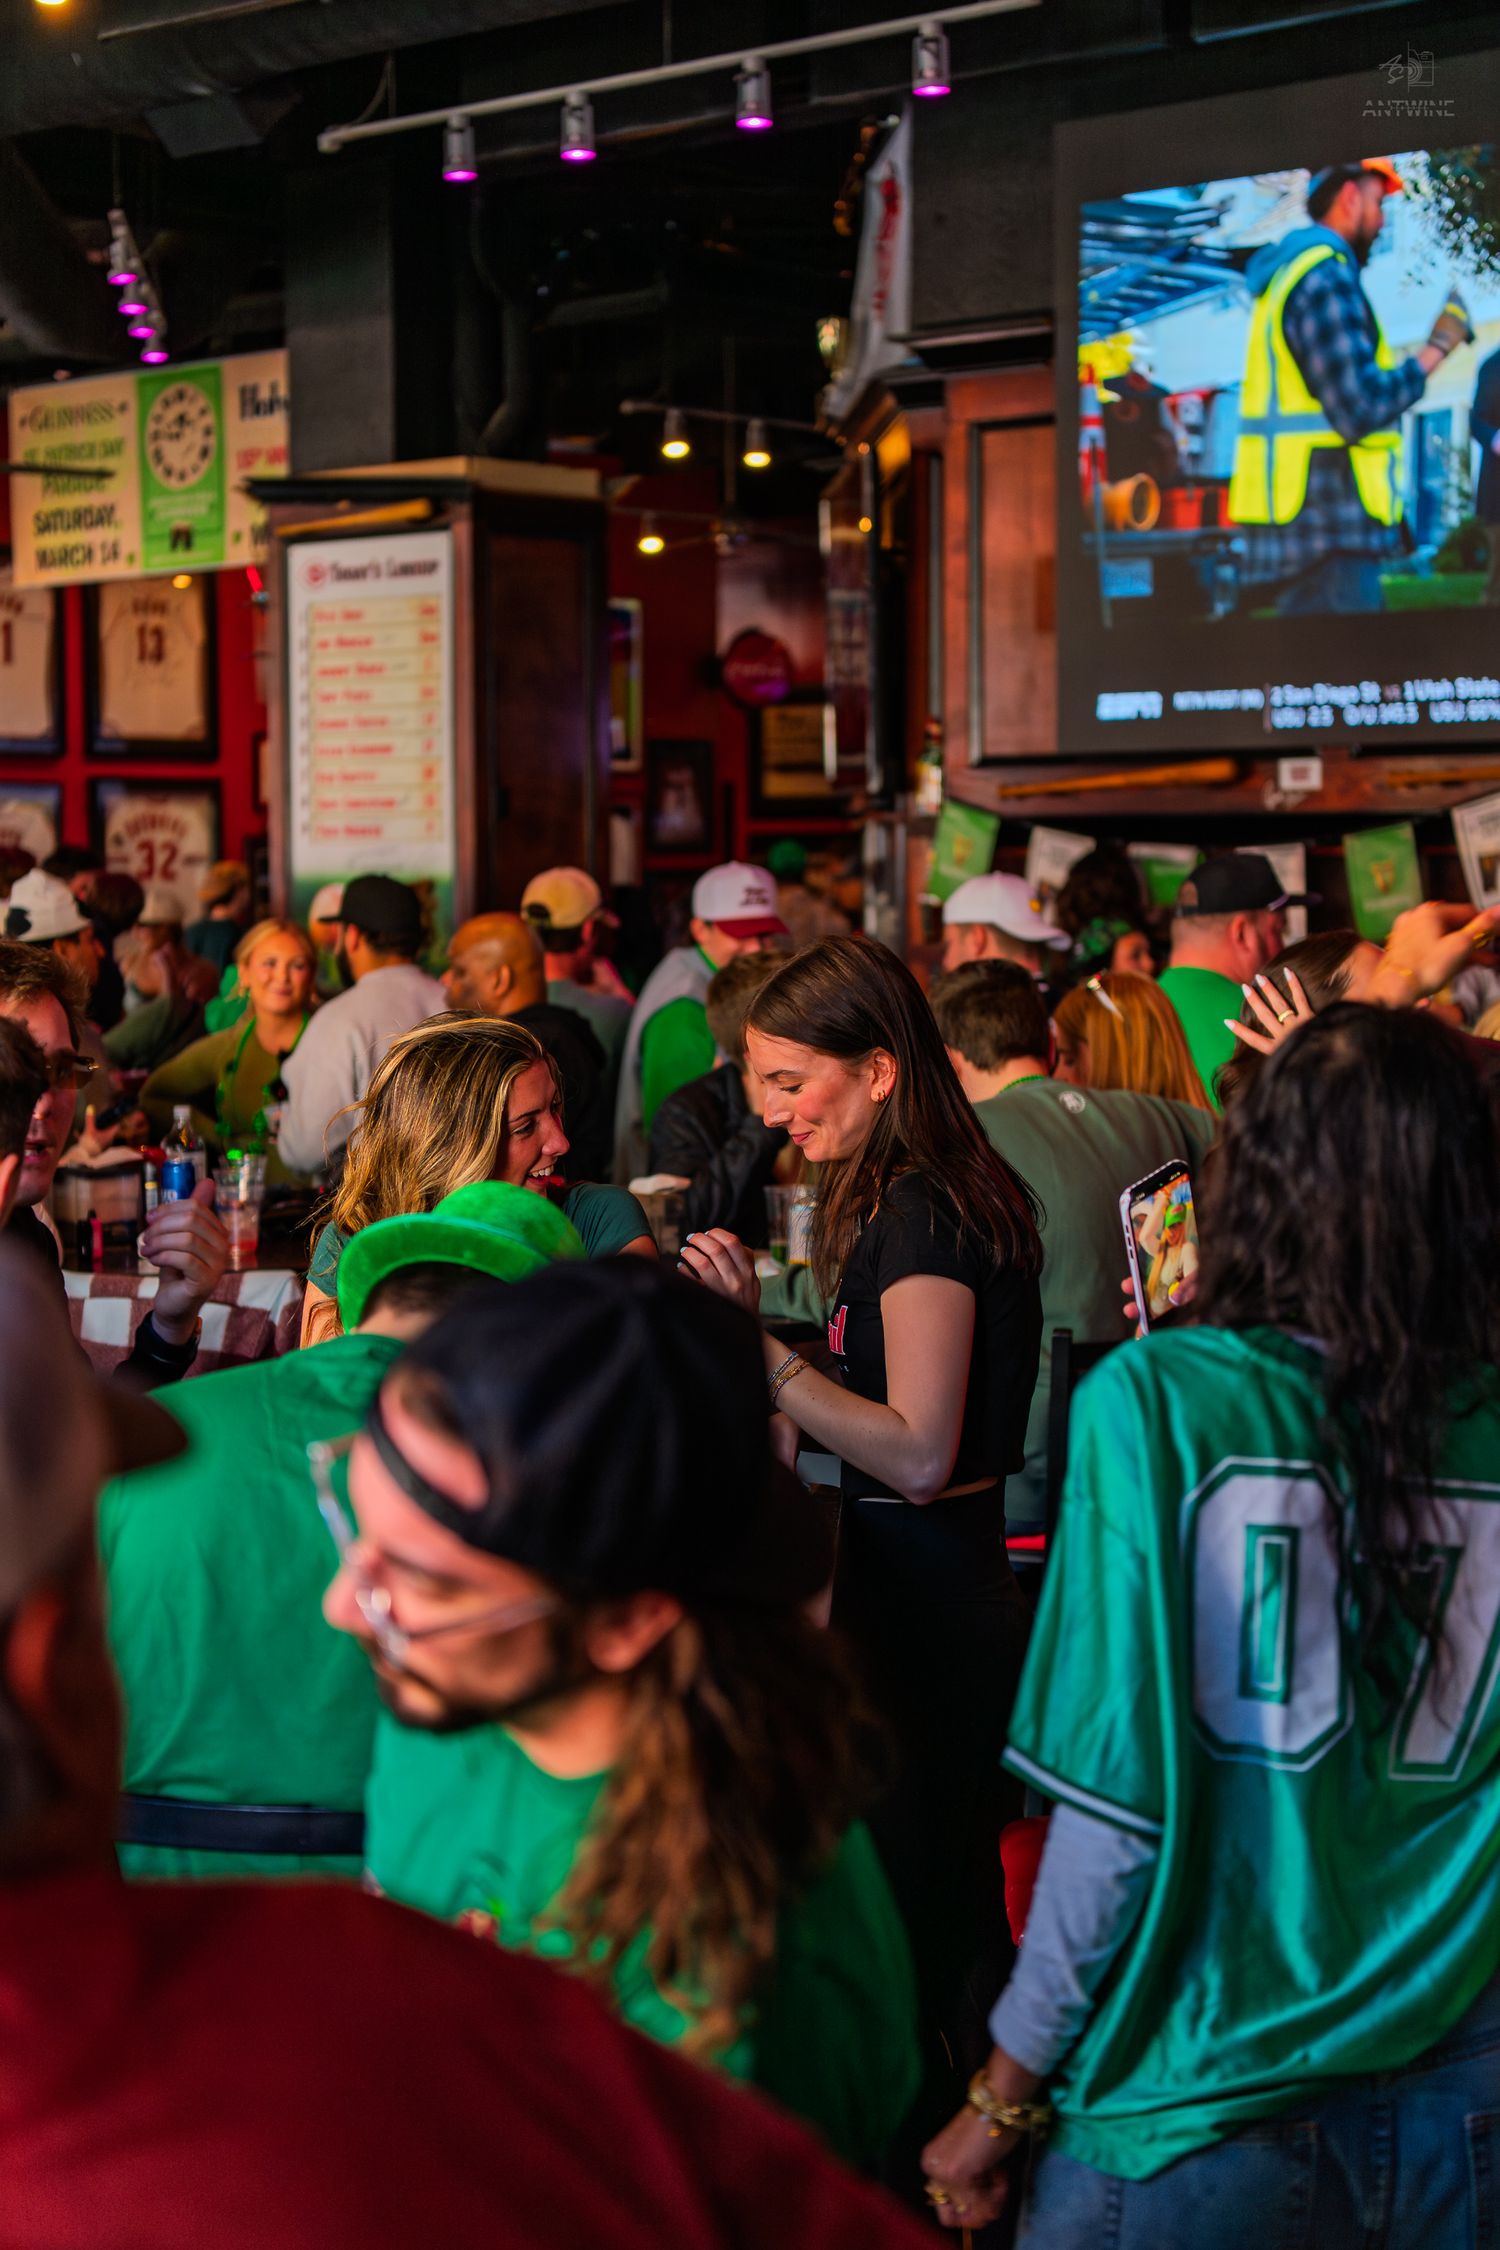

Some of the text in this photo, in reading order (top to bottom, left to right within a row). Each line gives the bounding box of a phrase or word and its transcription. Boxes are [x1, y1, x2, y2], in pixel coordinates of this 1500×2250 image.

[28, 400, 115, 433] GUINNESS
[36, 544, 95, 570] MARCH
[136, 622, 165, 664] 13
[135, 838, 179, 881] 32
[1180, 1455, 1500, 1786] 07
